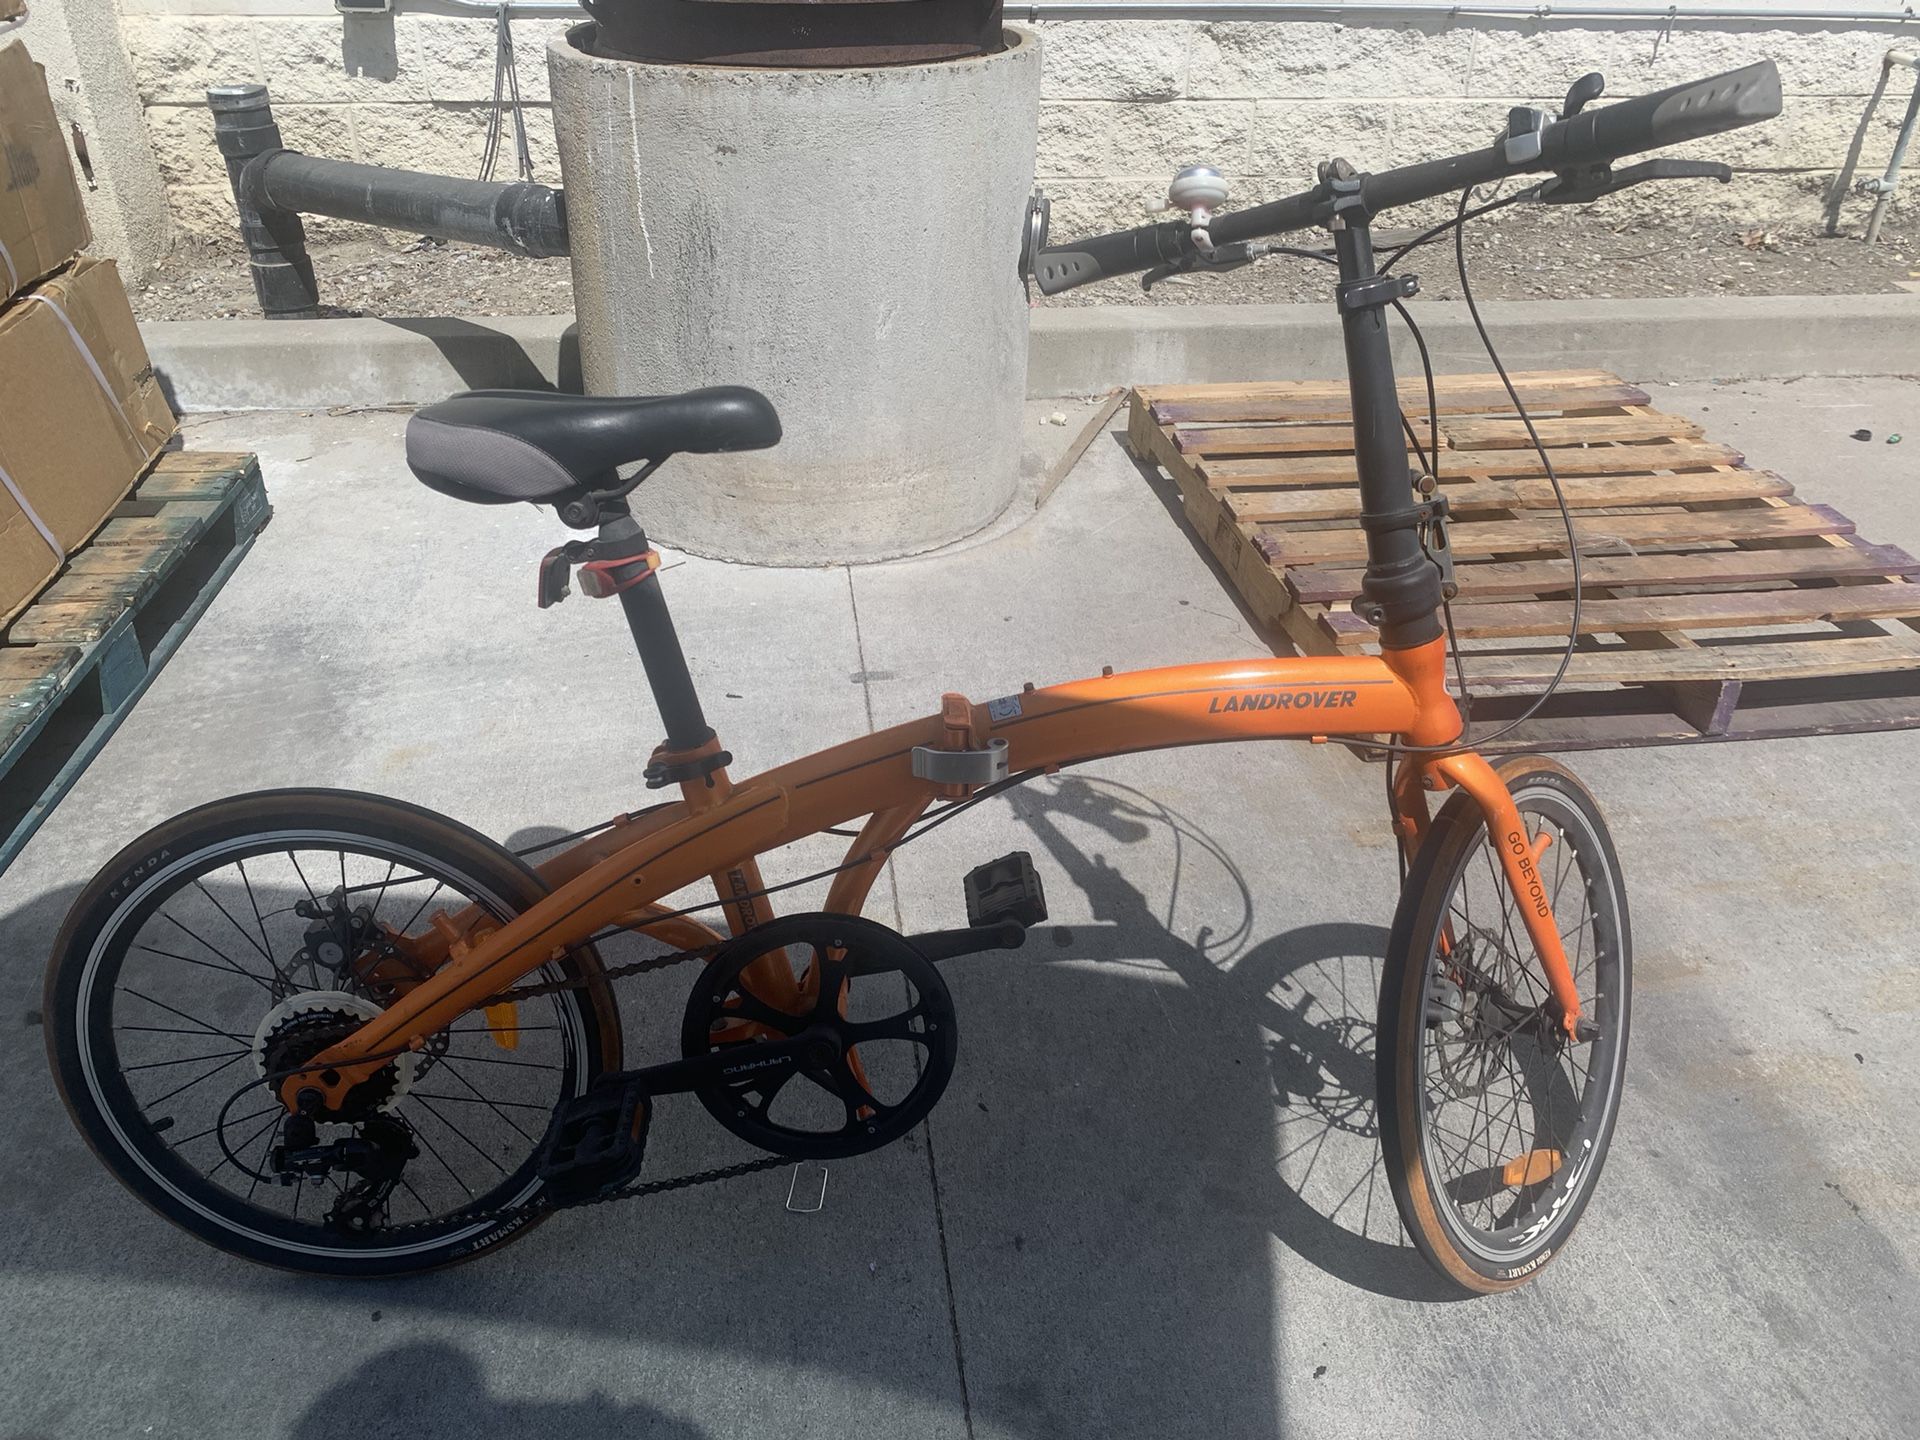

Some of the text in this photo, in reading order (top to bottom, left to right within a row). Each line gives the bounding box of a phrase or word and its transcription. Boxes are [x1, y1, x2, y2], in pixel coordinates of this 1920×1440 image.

[1208, 690, 1357, 714] LANDROVER
[110, 849, 170, 899] KENDA
[1508, 831, 1550, 918] GO BEYOND
